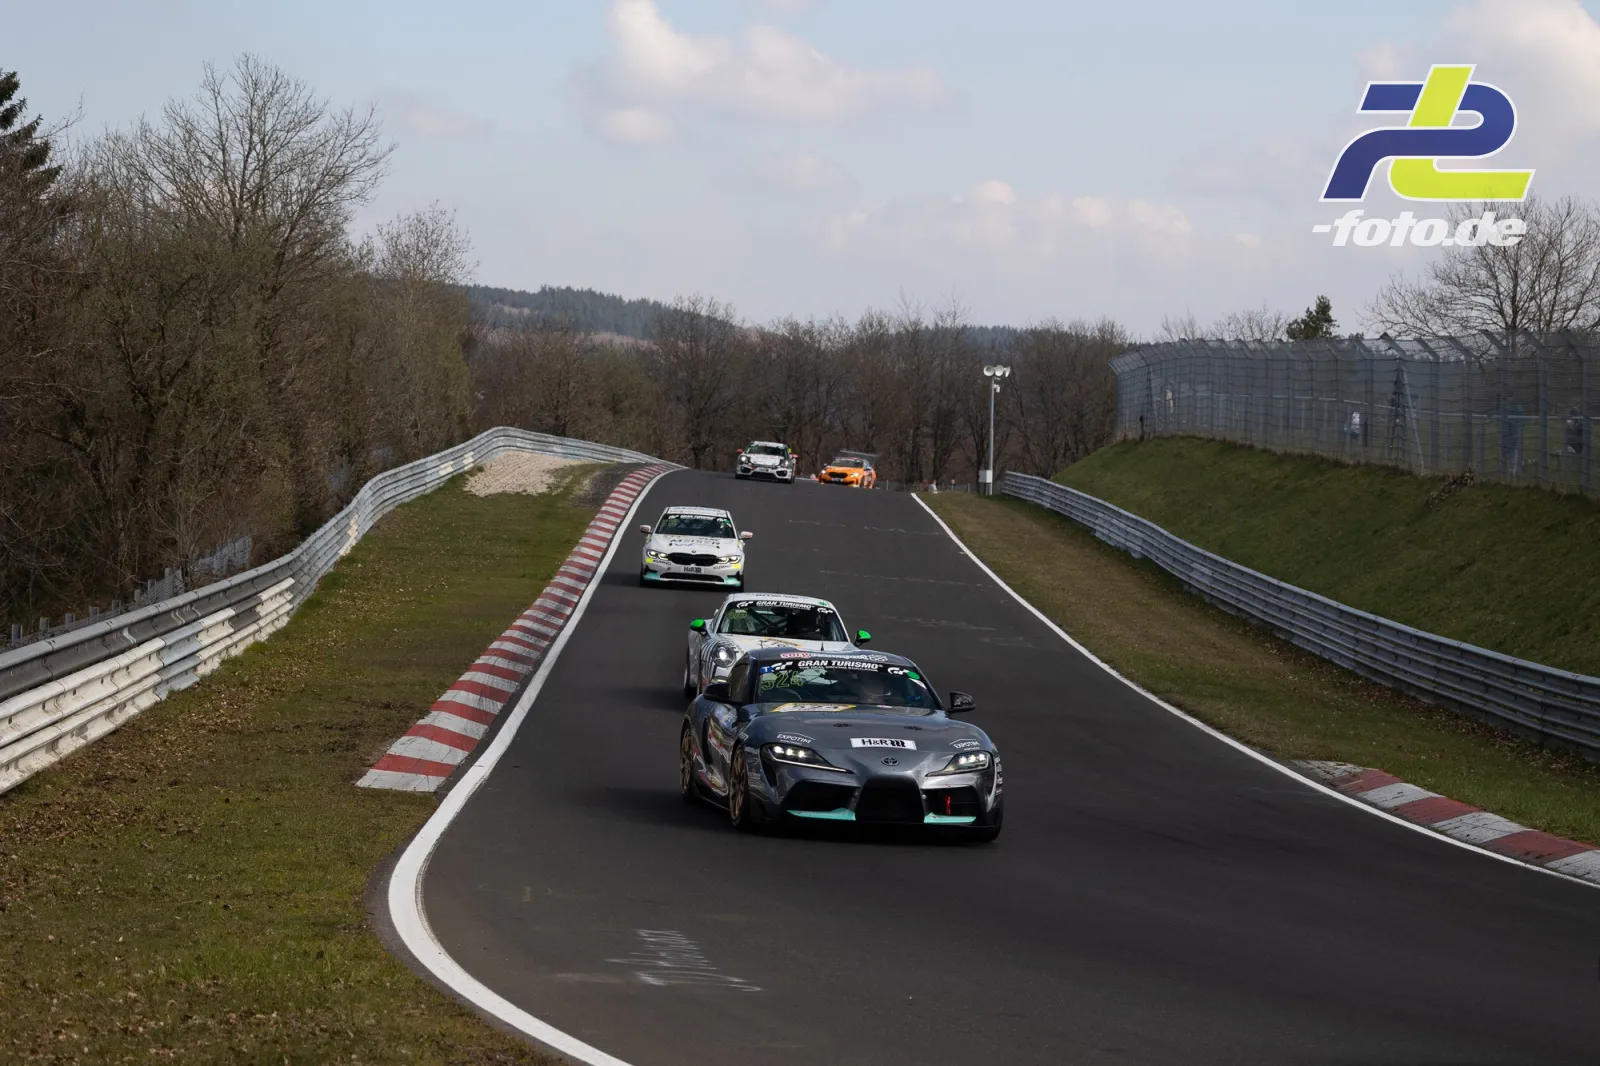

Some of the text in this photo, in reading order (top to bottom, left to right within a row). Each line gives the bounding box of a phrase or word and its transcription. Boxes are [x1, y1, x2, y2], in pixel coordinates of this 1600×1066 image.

[830, 660, 879, 669] TURISMO
[776, 733, 812, 744] EXPOTIM
[861, 738, 890, 746] H&R
